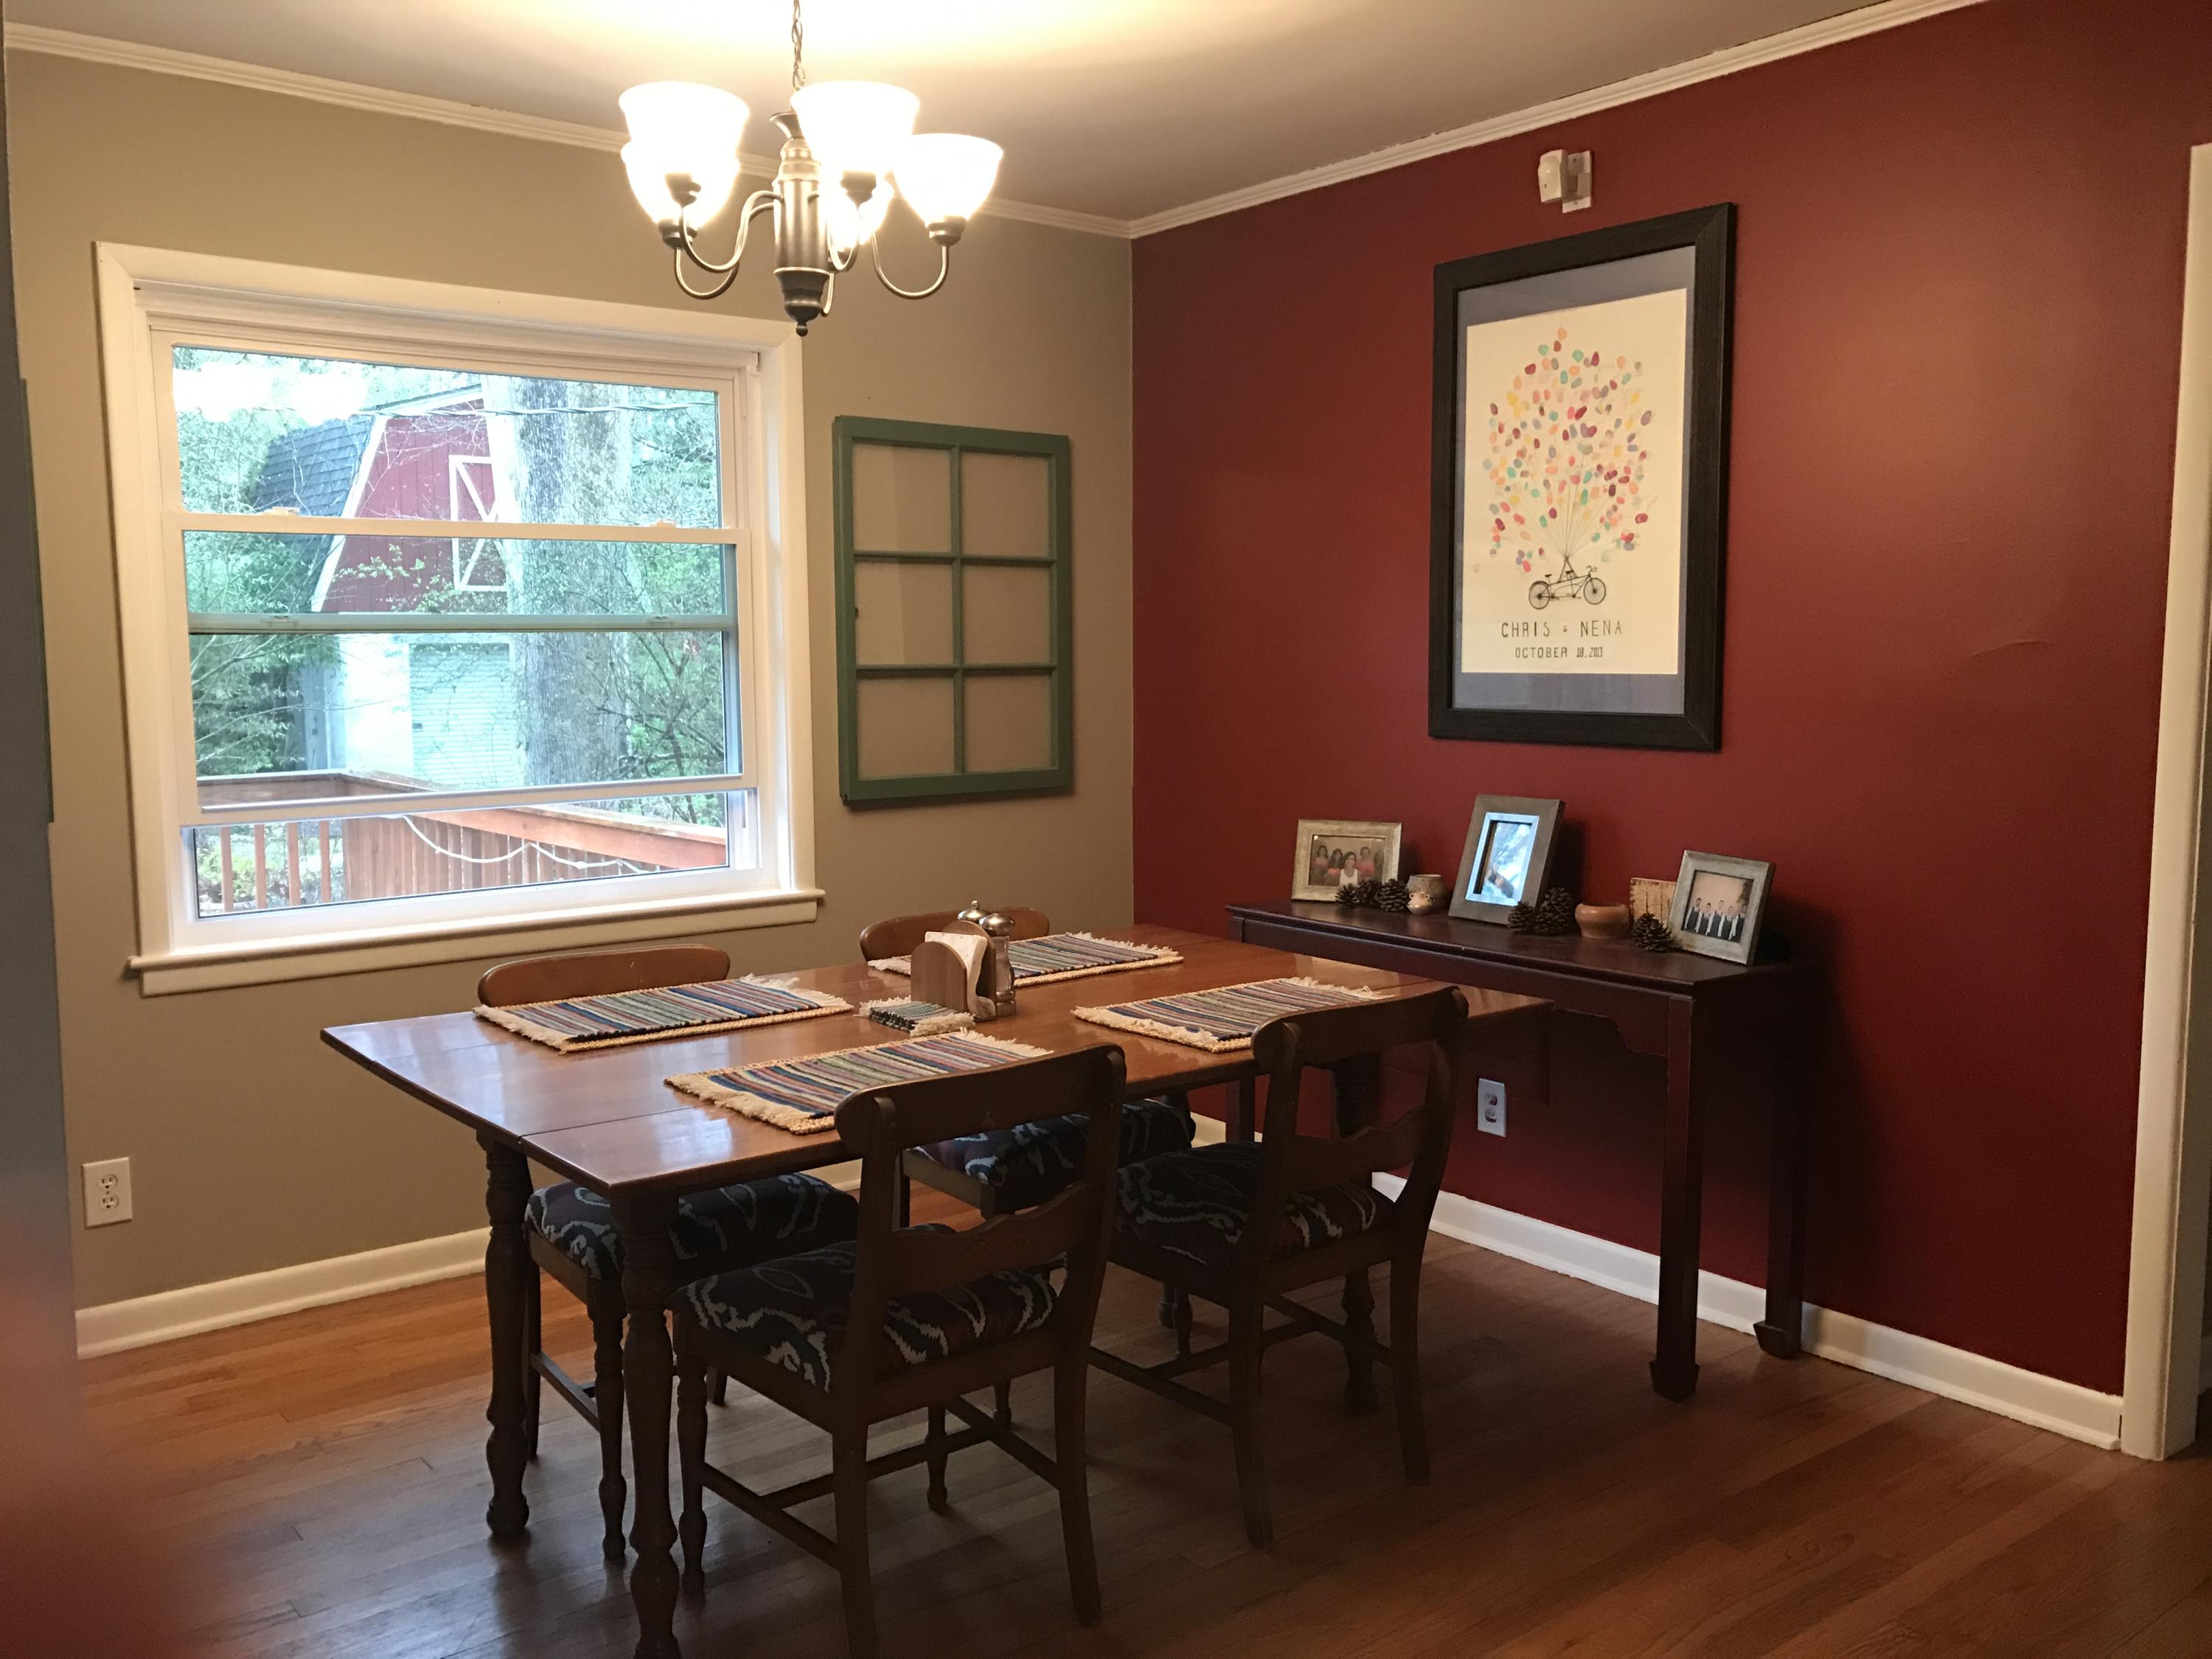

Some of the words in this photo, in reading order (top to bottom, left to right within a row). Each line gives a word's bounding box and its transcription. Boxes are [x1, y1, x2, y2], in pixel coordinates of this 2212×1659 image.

[1501, 622, 1550, 638] CHRIS
[1580, 620, 1622, 637] NENA
[1515, 647, 1568, 658] OCTOBER
